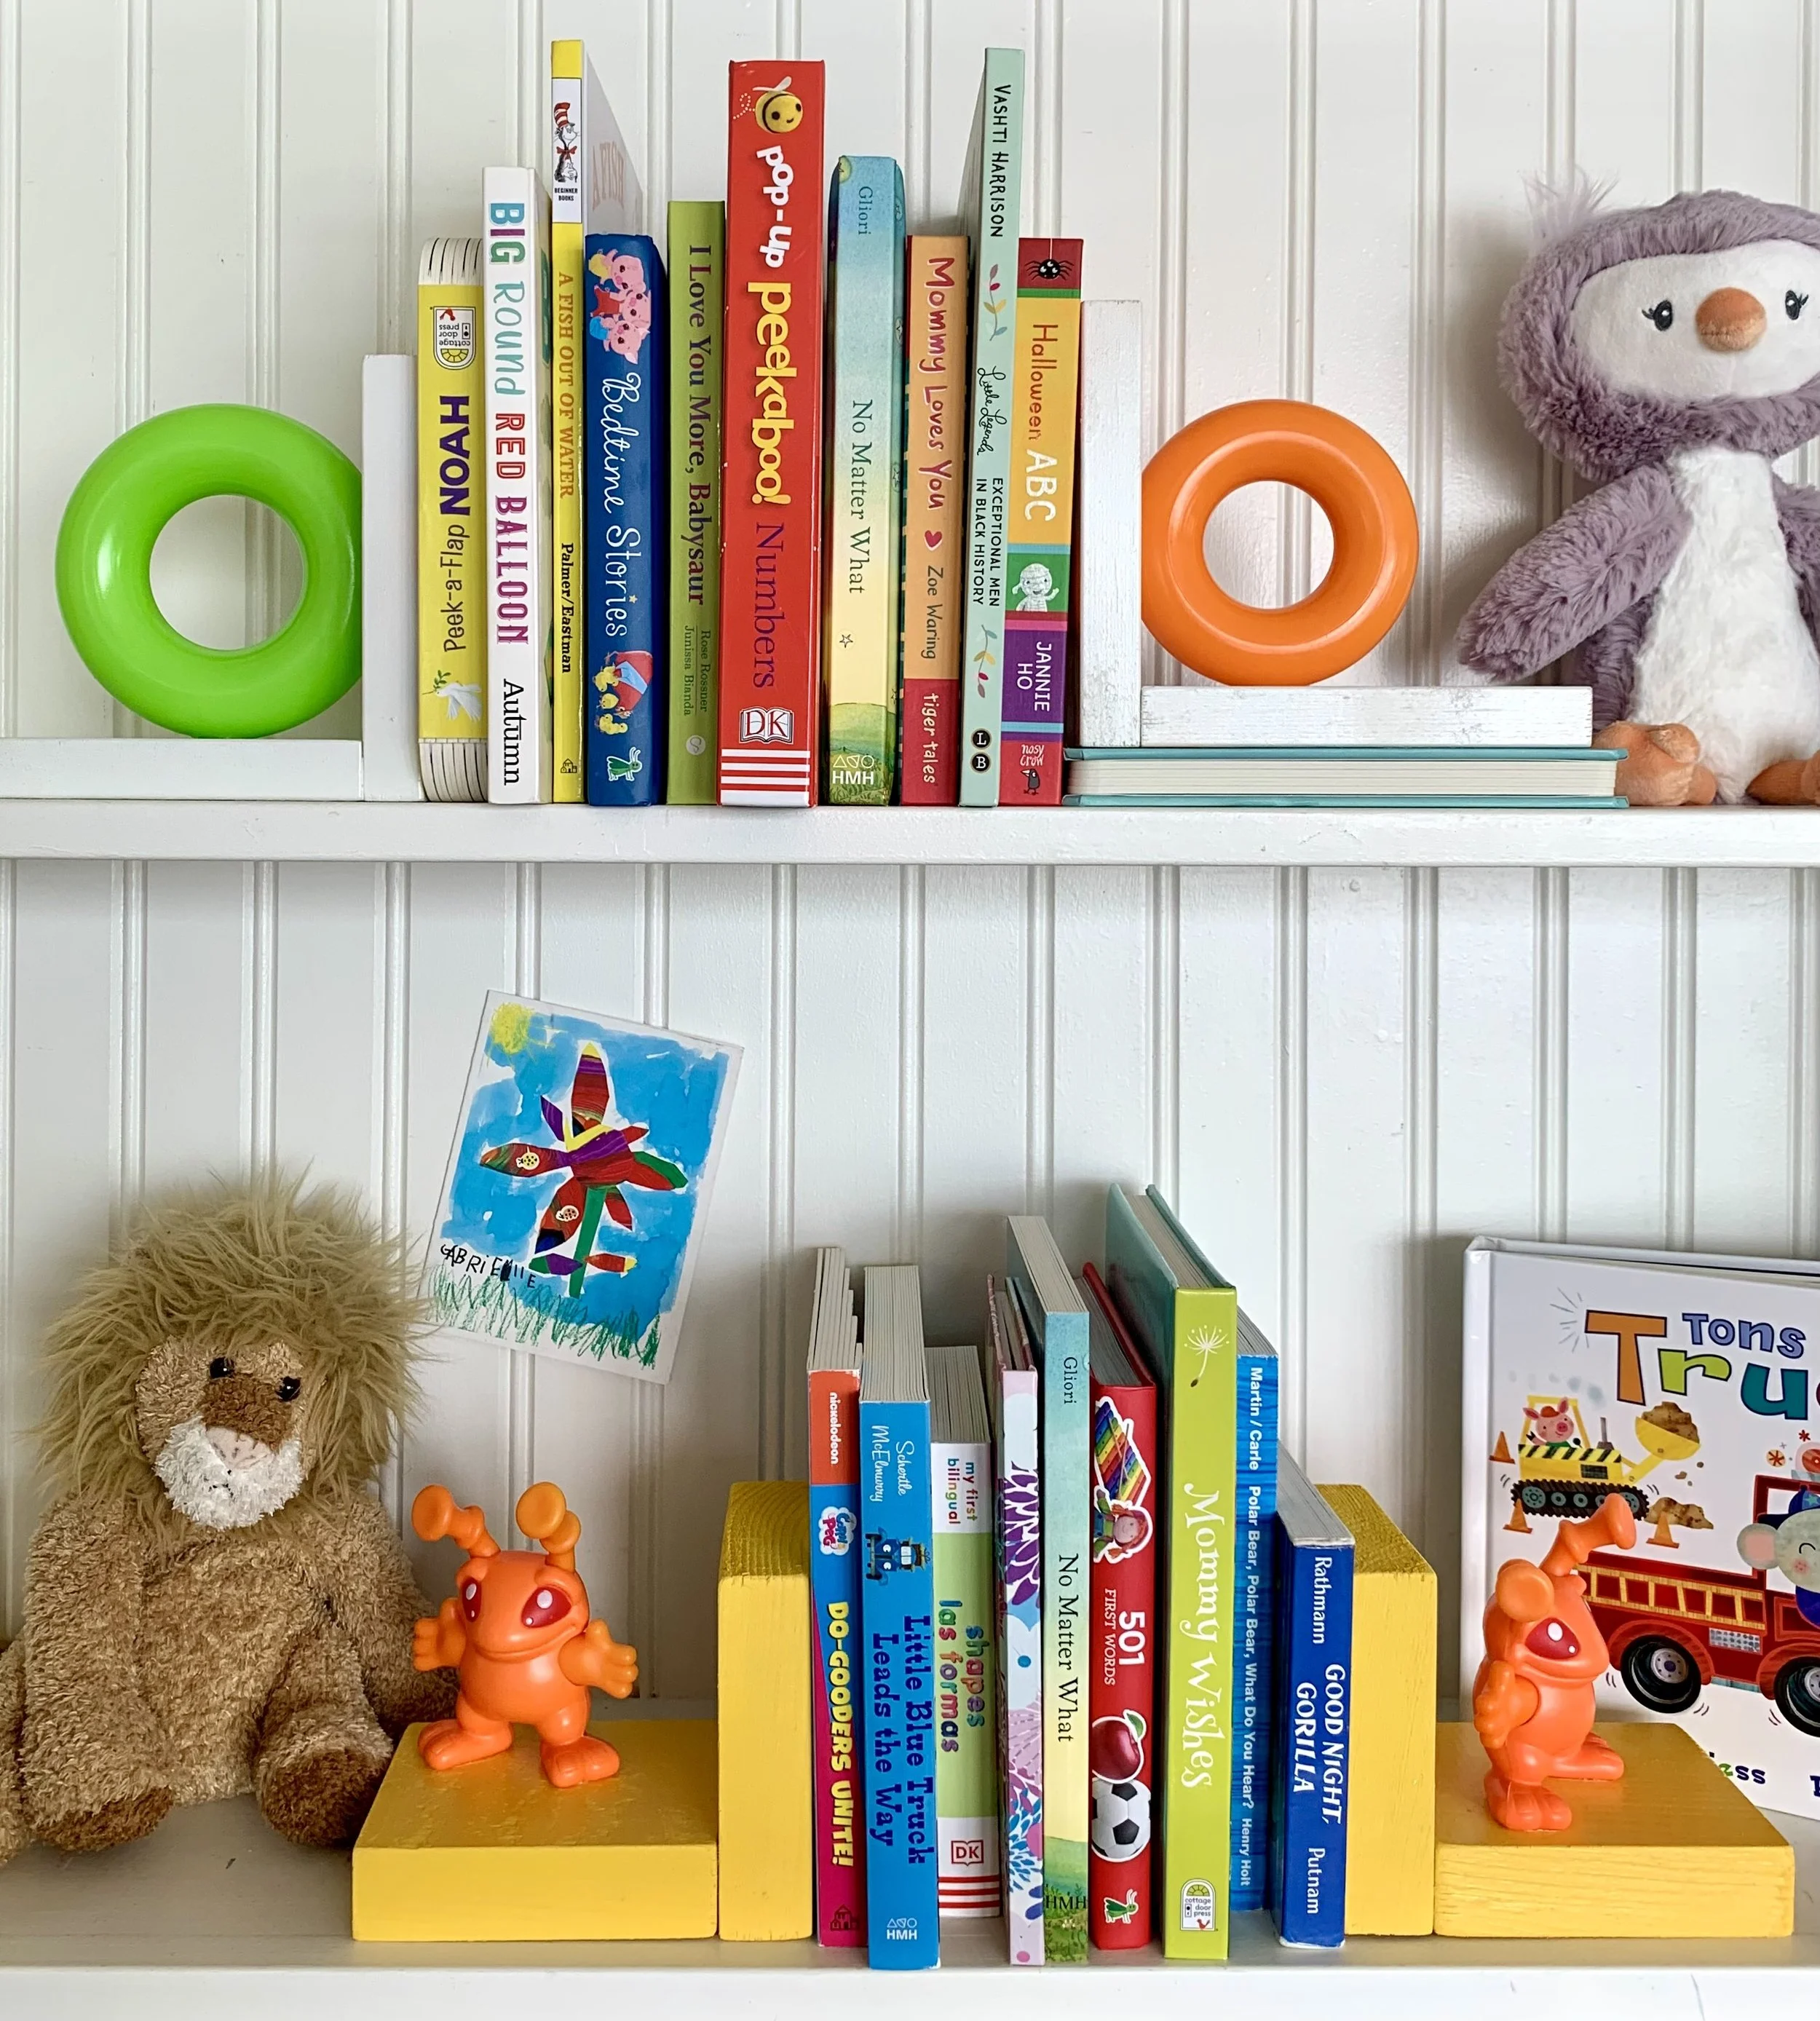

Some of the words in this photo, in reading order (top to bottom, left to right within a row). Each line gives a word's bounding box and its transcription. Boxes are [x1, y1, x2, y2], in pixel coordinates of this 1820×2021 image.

[992, 84, 1011, 143] VASHTI
[756, 145, 794, 269] pop-up
[858, 186, 873, 236] Gliori
[989, 151, 1009, 237] HARRISON
[489, 202, 526, 264] BIG
[689, 245, 712, 256] I
[558, 272, 573, 286] A
[689, 263, 712, 328] Love
[558, 296, 573, 340] FISH
[917, 257, 955, 373] Mommy
[558, 346, 574, 387] OUT
[689, 333, 711, 389] You
[977, 365, 1006, 406] Little
[1029, 324, 1059, 440] Halloween
[558, 393, 575, 420] OF
[747, 282, 798, 505] peekaboo!
[852, 399, 872, 434] No
[923, 384, 948, 451] Loves
[439, 395, 470, 516] NOAH
[494, 413, 526, 480] RED
[601, 372, 642, 514] Bedtime
[684, 395, 711, 472] More,
[976, 408, 1007, 456] Legends
[559, 425, 575, 499] WATER
[850, 442, 872, 520] Matter
[918, 459, 952, 512] You
[976, 478, 986, 491] IN
[1024, 448, 1057, 521] ABC
[681, 483, 711, 606] Babysaur
[974, 498, 986, 537] BLACK
[989, 478, 1003, 572] EXCEPTIONAL
[495, 495, 529, 645] BALLOON
[605, 525, 641, 638] Stories
[849, 526, 870, 594] What
[927, 565, 943, 596] Zoe
[973, 544, 985, 605] HISTORY
[440, 523, 470, 653] Peek-a-Flap
[561, 542, 574, 673] Palmer/Eastman
[753, 521, 785, 689] Numbers
[989, 577, 1000, 606] MEN
[684, 625, 693, 671] Junissa
[697, 630, 711, 656] Rose
[921, 604, 943, 660] Waring
[683, 674, 693, 716] Bianda
[697, 660, 708, 713] Rossner
[1016, 663, 1033, 690] HO
[1034, 641, 1052, 712] JANNIE
[503, 679, 524, 786] Autumn
[745, 710, 786, 738] DK
[922, 692, 940, 741] tiger
[976, 732, 986, 745] L
[831, 771, 874, 786] HMH
[922, 744, 940, 785] tales
[976, 756, 986, 769] B
[1020, 756, 1043, 767] crow
[1021, 744, 1044, 760] nosy
[1682, 1312, 1806, 1359] Tons
[1063, 1356, 1078, 1404] Gliori
[1250, 1367, 1263, 1417] Martin
[1584, 1309, 1820, 1421] Tru
[829, 1392, 842, 1466] nickelodeon
[1249, 1430, 1262, 1471] Carle
[869, 1425, 890, 1503] McElmurry
[895, 1441, 915, 1497] Schertle
[946, 1458, 961, 1524] bilingual
[962, 1462, 975, 1484] my
[965, 1488, 978, 1522] first
[1248, 1486, 1261, 1526] Polar
[1059, 1553, 1079, 1586] No
[1179, 1482, 1225, 1643] Mommy
[1246, 1530, 1260, 1570] Bear,
[938, 1600, 962, 1640] las
[1104, 1588, 1117, 1630] FIRST
[1246, 1575, 1259, 1614] Polar
[1313, 1557, 1332, 1645] Rathmann
[904, 1615, 931, 1690] Little
[1059, 1594, 1079, 1671] Matter
[1104, 1634, 1116, 1686] WORDS
[1118, 1611, 1145, 1666] 501
[1243, 1618, 1258, 1658] Bear,
[828, 1602, 852, 1772] DO-GOODERS
[873, 1633, 901, 1718] Leads
[939, 1650, 963, 1752] formas
[960, 1625, 990, 1728] shapes
[1244, 1662, 1257, 1702] What
[1324, 1664, 1346, 1736] GOOD
[906, 1701, 933, 1767] Blue
[1058, 1677, 1078, 1742] What
[1181, 1651, 1225, 1788] Wishes
[1243, 1706, 1257, 1728] Do
[874, 1728, 901, 1773] the
[1243, 1731, 1256, 1760] You
[1293, 1682, 1318, 1793] GORILLA
[1242, 1765, 1255, 1809] Hear?
[1321, 1741, 1345, 1825] NIGHT,
[831, 1780, 854, 1867] UNITE!
[869, 1784, 903, 1847] Way
[907, 1777, 935, 1864] Truck
[1239, 1818, 1252, 1856] Henry
[956, 1846, 980, 1859] DK
[1240, 1859, 1251, 1886] Holt
[1045, 1895, 1087, 1910] HMH
[1307, 1847, 1326, 1914] Putnam
[886, 1929, 918, 1940] HMH
